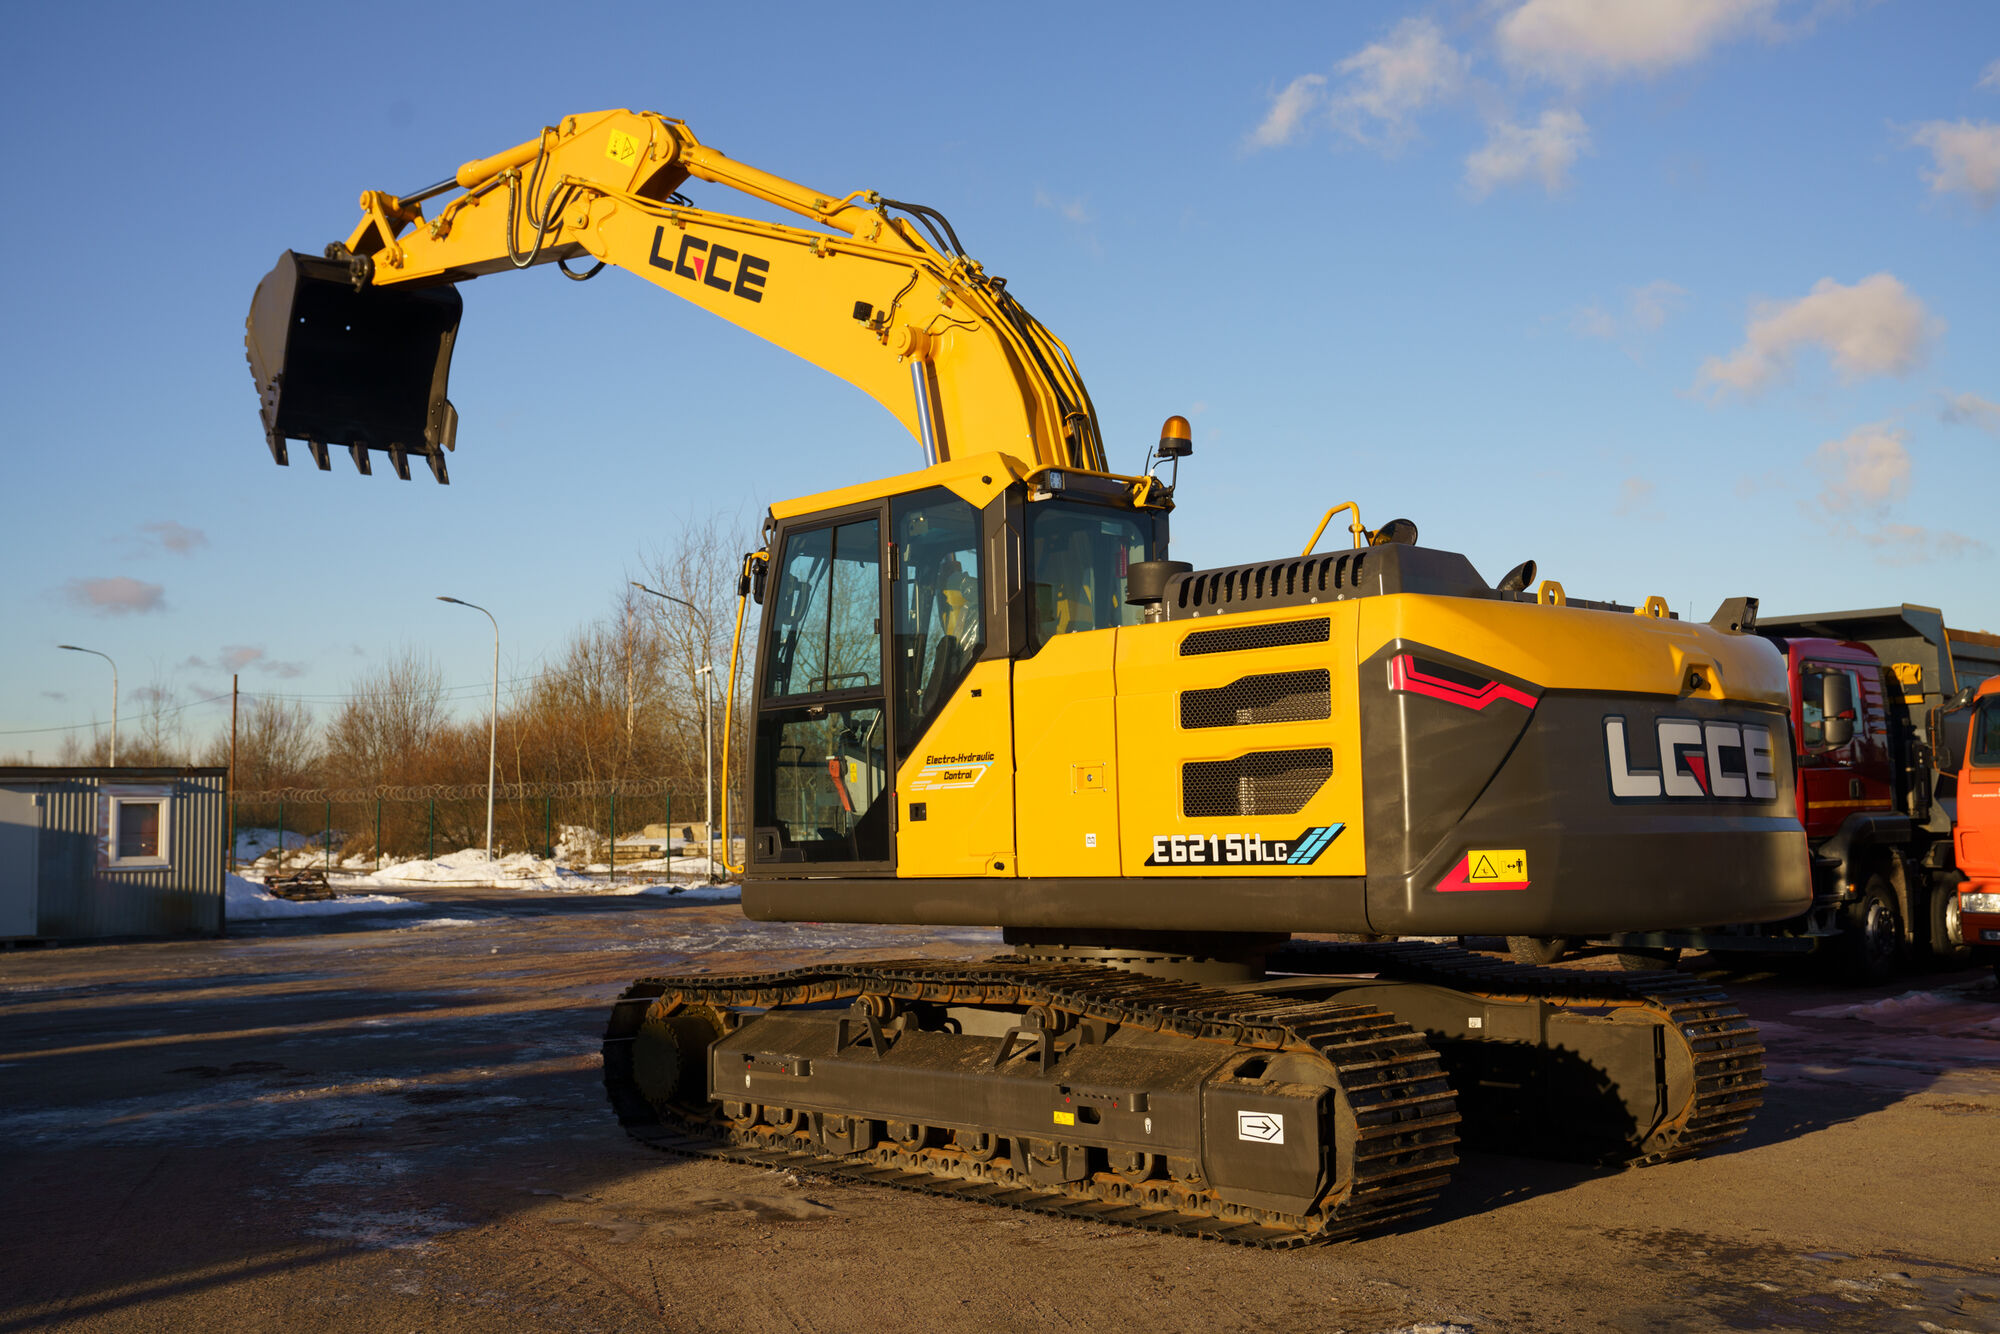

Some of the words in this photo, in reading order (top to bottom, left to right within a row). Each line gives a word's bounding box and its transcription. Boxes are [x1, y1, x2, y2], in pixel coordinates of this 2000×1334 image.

[649, 225, 770, 303] LGCE
[926, 751, 995, 765] Electro-Hydraulic
[943, 770, 973, 780] Control
[1603, 716, 1777, 799] LGCE
